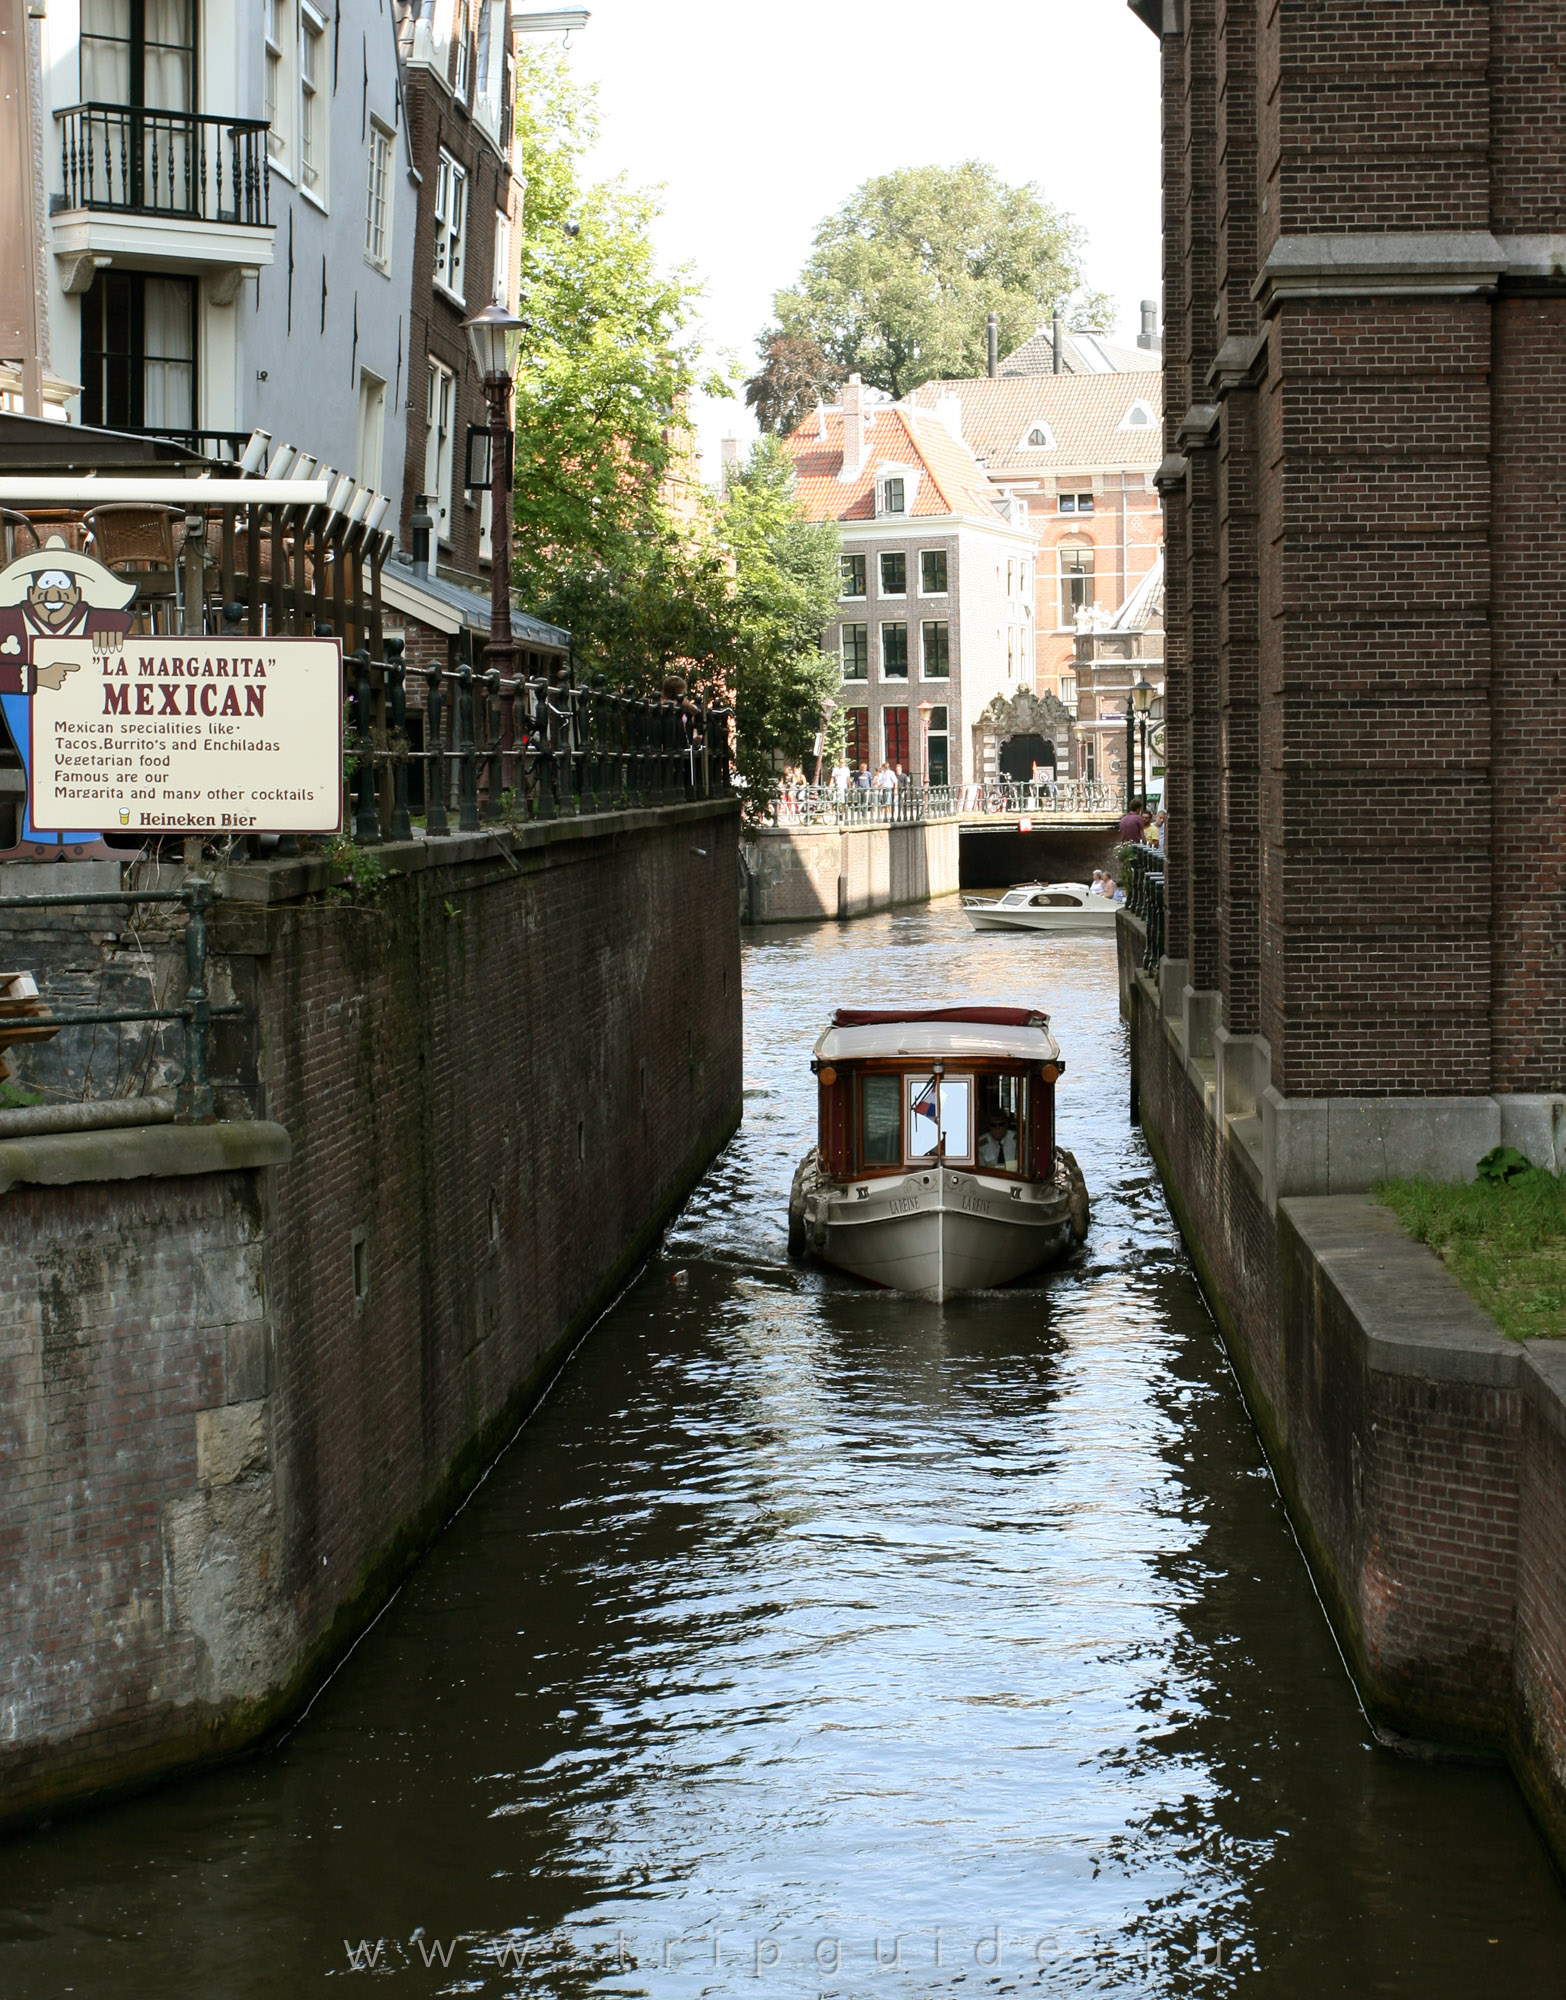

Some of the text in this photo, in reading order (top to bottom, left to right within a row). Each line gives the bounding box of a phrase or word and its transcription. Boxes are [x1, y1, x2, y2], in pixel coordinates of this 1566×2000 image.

[102, 683, 267, 718] MEXICAN
[54, 720, 114, 734] Mexican
[120, 722, 202, 735] specialities
[172, 738, 197, 751] and
[203, 739, 281, 752] Enchiladas
[54, 754, 171, 768] Vegetarian food
[54, 770, 170, 783] Famous are our
[54, 787, 314, 801] Margarita and many other cocktails
[139, 812, 257, 827] Heineken Bier
